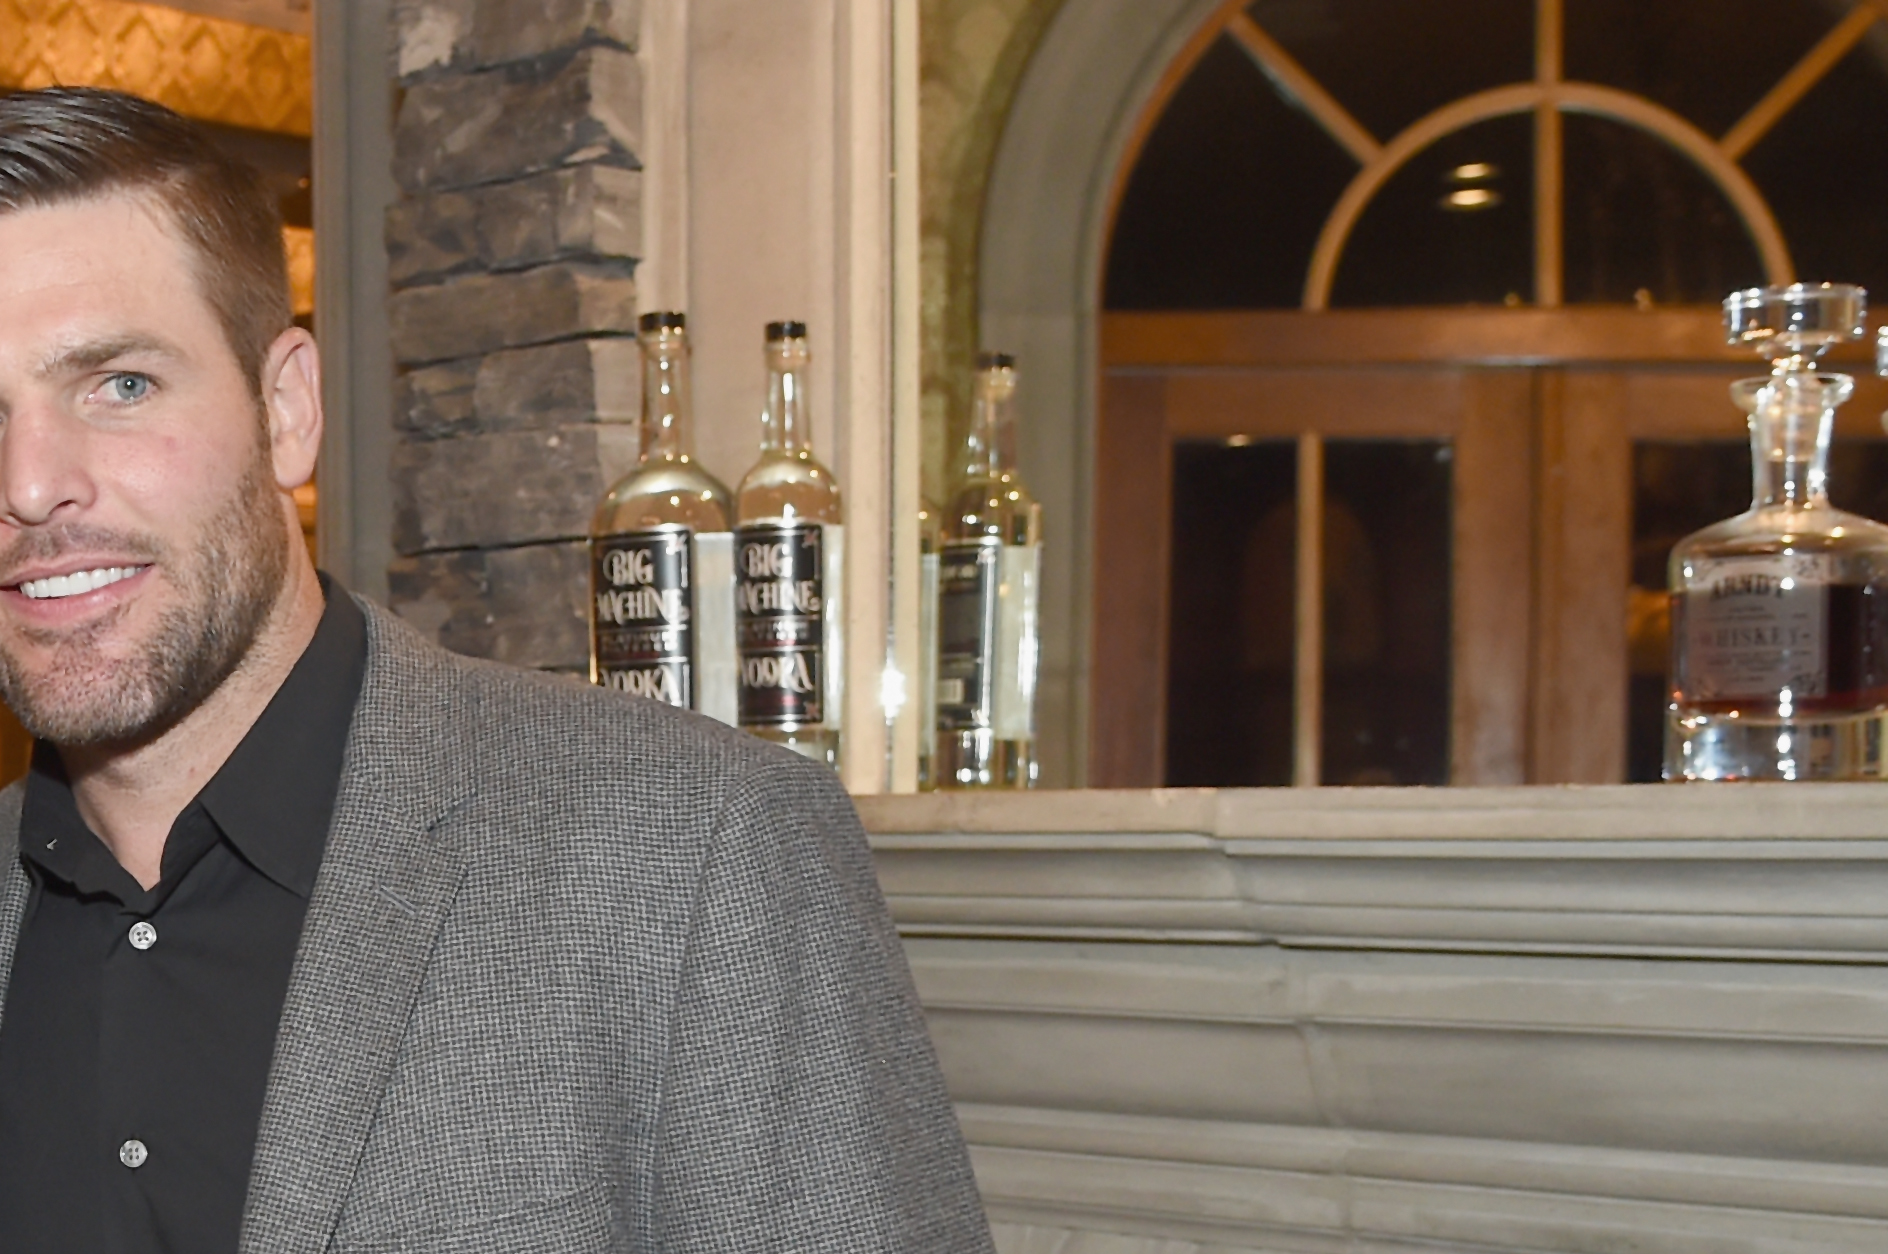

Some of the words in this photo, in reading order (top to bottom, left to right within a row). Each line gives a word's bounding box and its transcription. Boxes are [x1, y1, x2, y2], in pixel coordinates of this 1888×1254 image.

[602, 548, 655, 586] BIG
[739, 541, 794, 578] BIG
[595, 585, 690, 626] MACHINE
